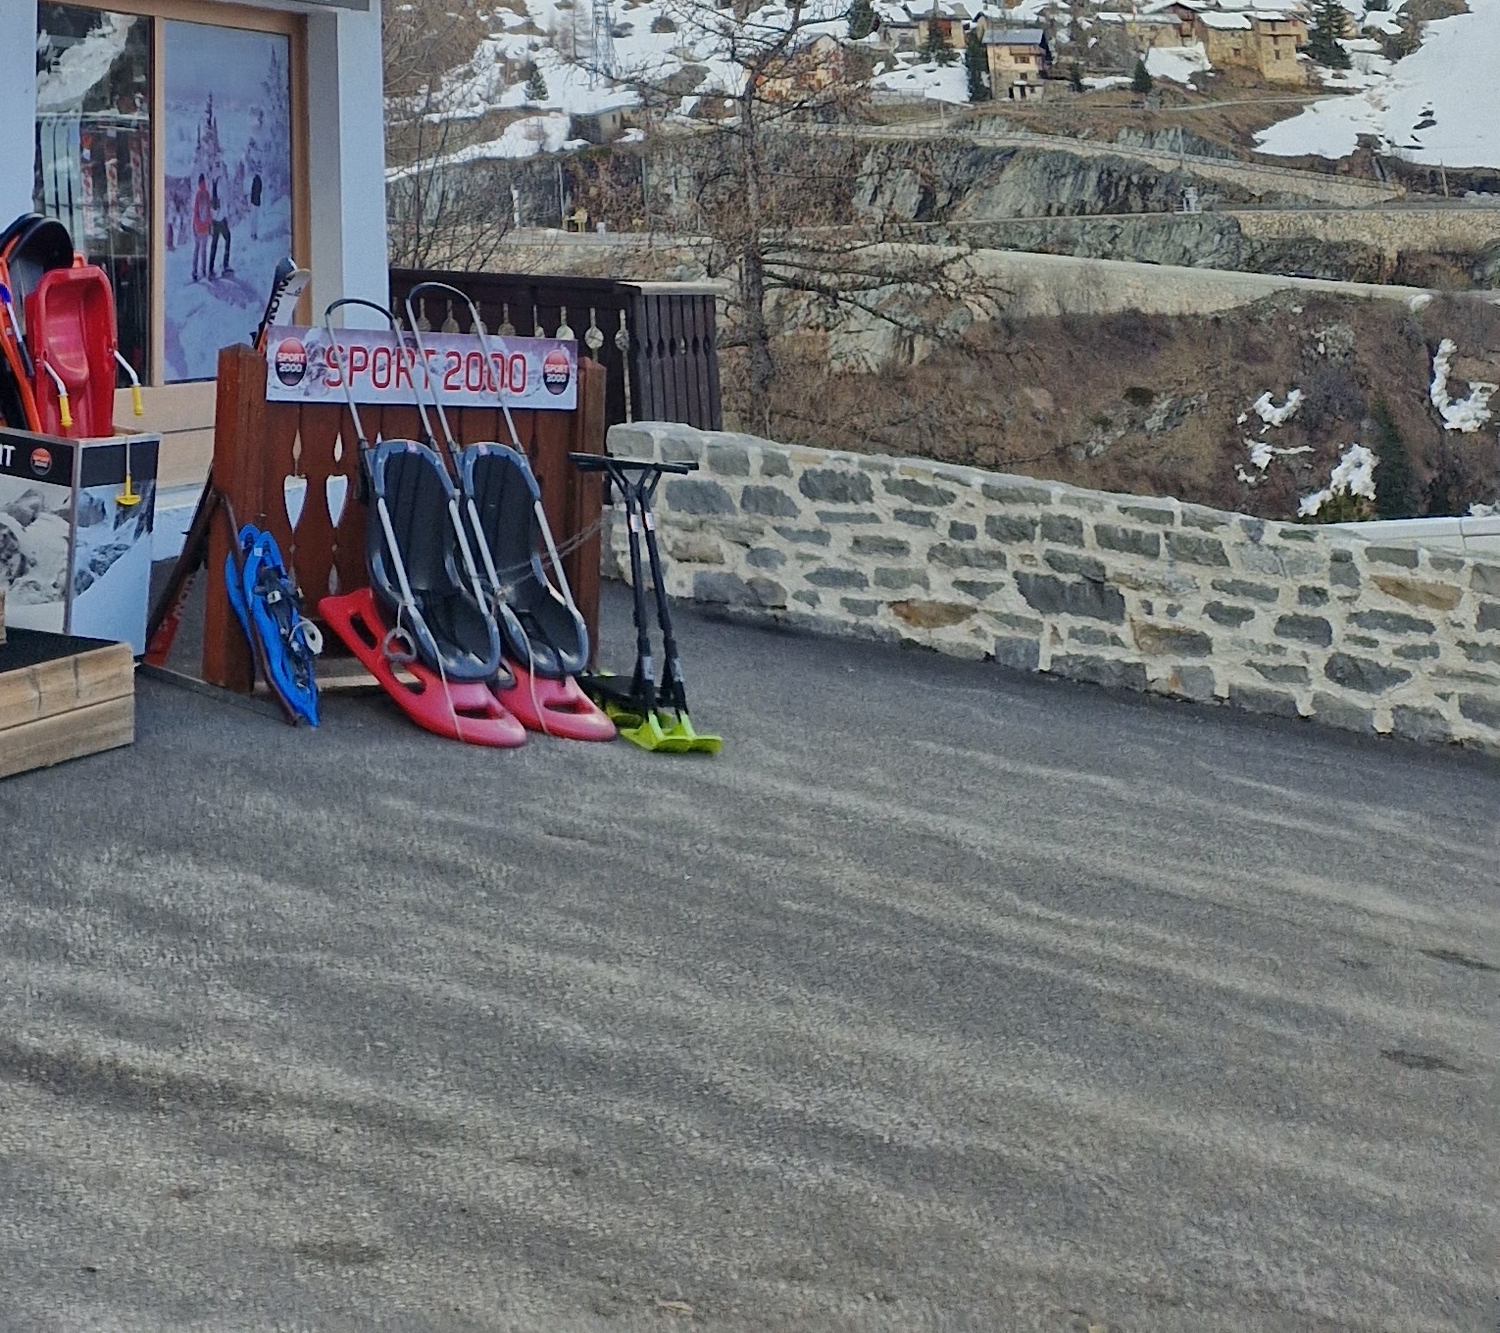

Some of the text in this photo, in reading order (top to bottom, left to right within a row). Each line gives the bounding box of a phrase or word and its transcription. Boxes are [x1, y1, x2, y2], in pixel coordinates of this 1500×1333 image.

[277, 351, 306, 364] SPORT
[278, 362, 303, 374] 2000
[324, 344, 527, 394] SPORT 2000
[544, 362, 569, 375] SPORT
[546, 372, 568, 384] 2000
